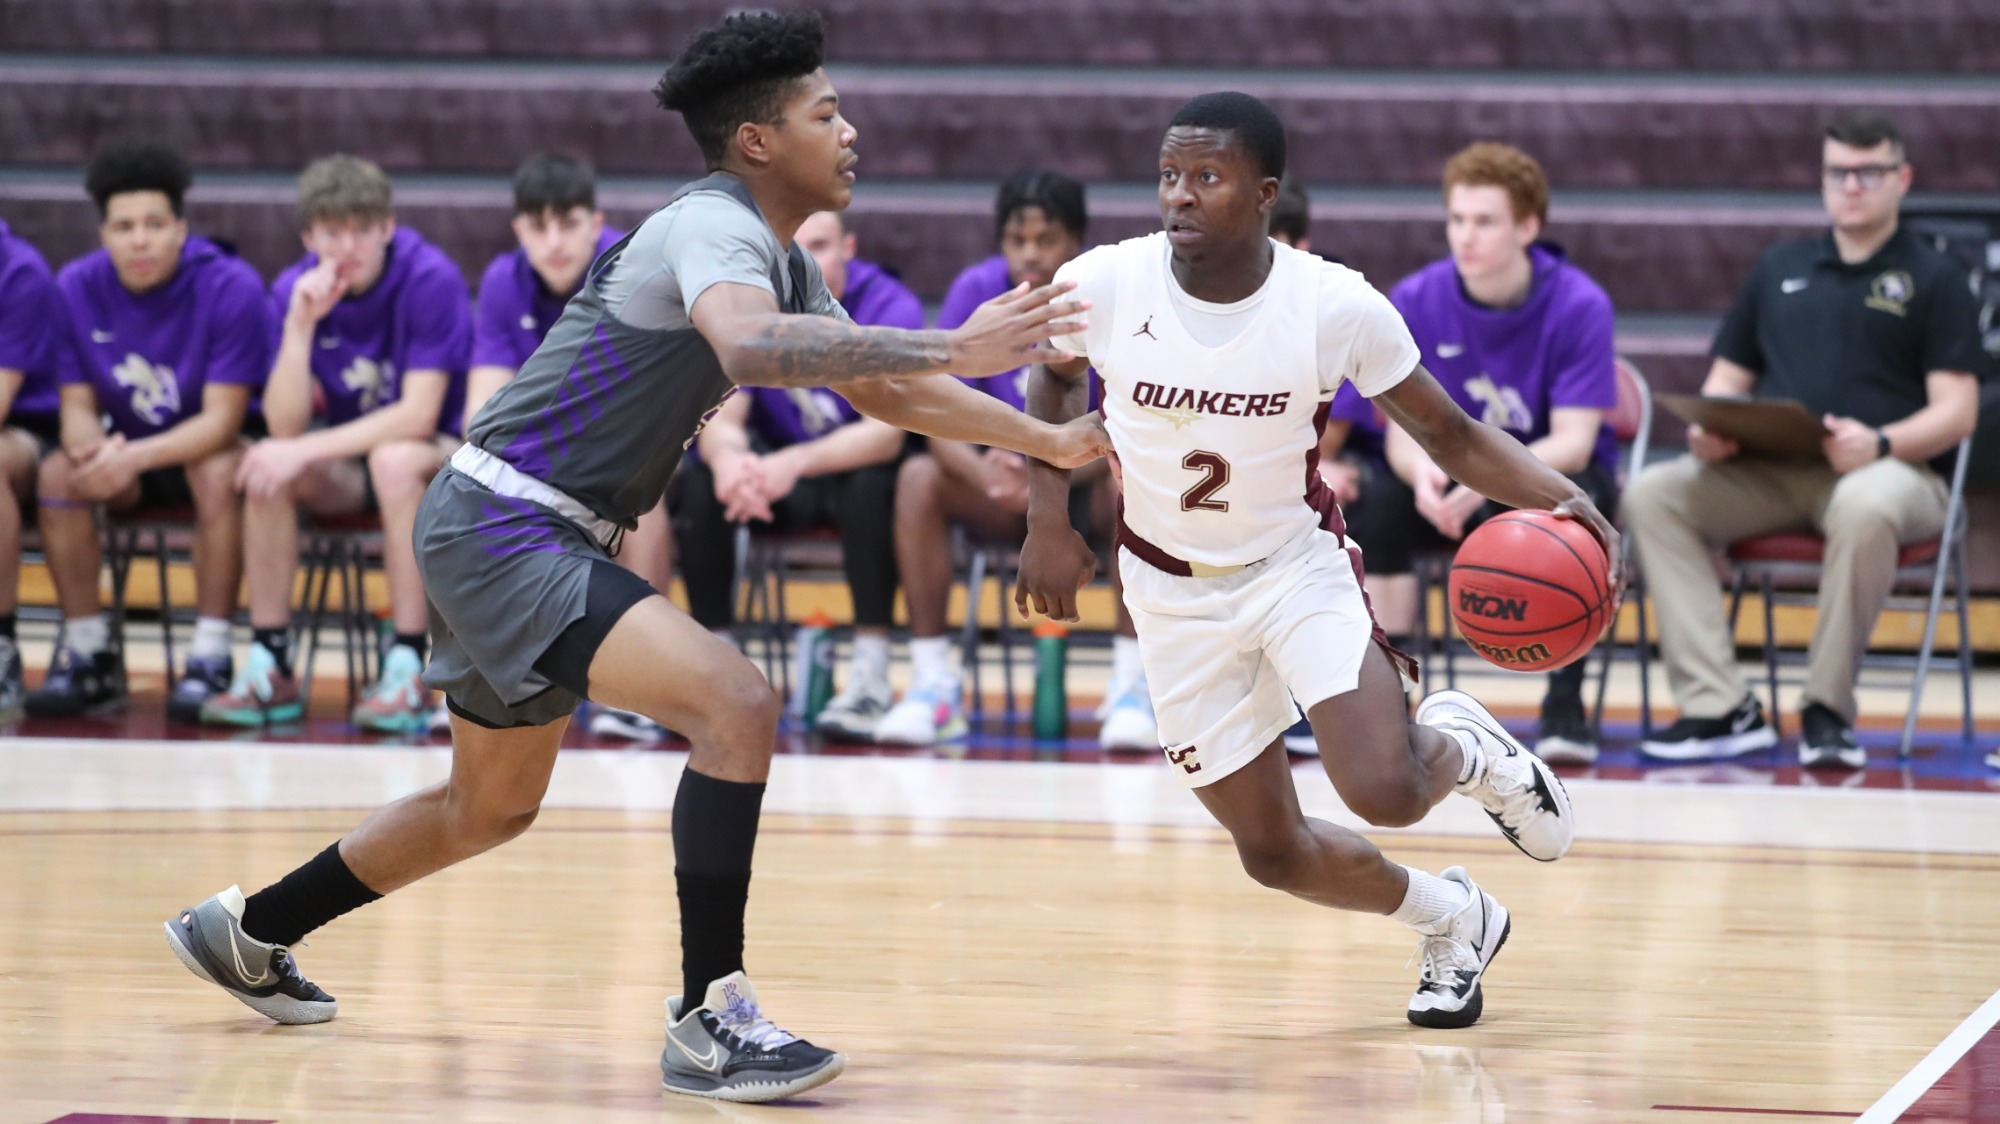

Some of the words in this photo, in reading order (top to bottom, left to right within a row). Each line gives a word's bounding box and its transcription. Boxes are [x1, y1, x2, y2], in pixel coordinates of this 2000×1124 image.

[1133, 381, 1291, 417] QUAKERS
[1181, 450, 1231, 512] 2
[1460, 589, 1528, 621] NCAA
[1467, 638, 1552, 662] Wilso
